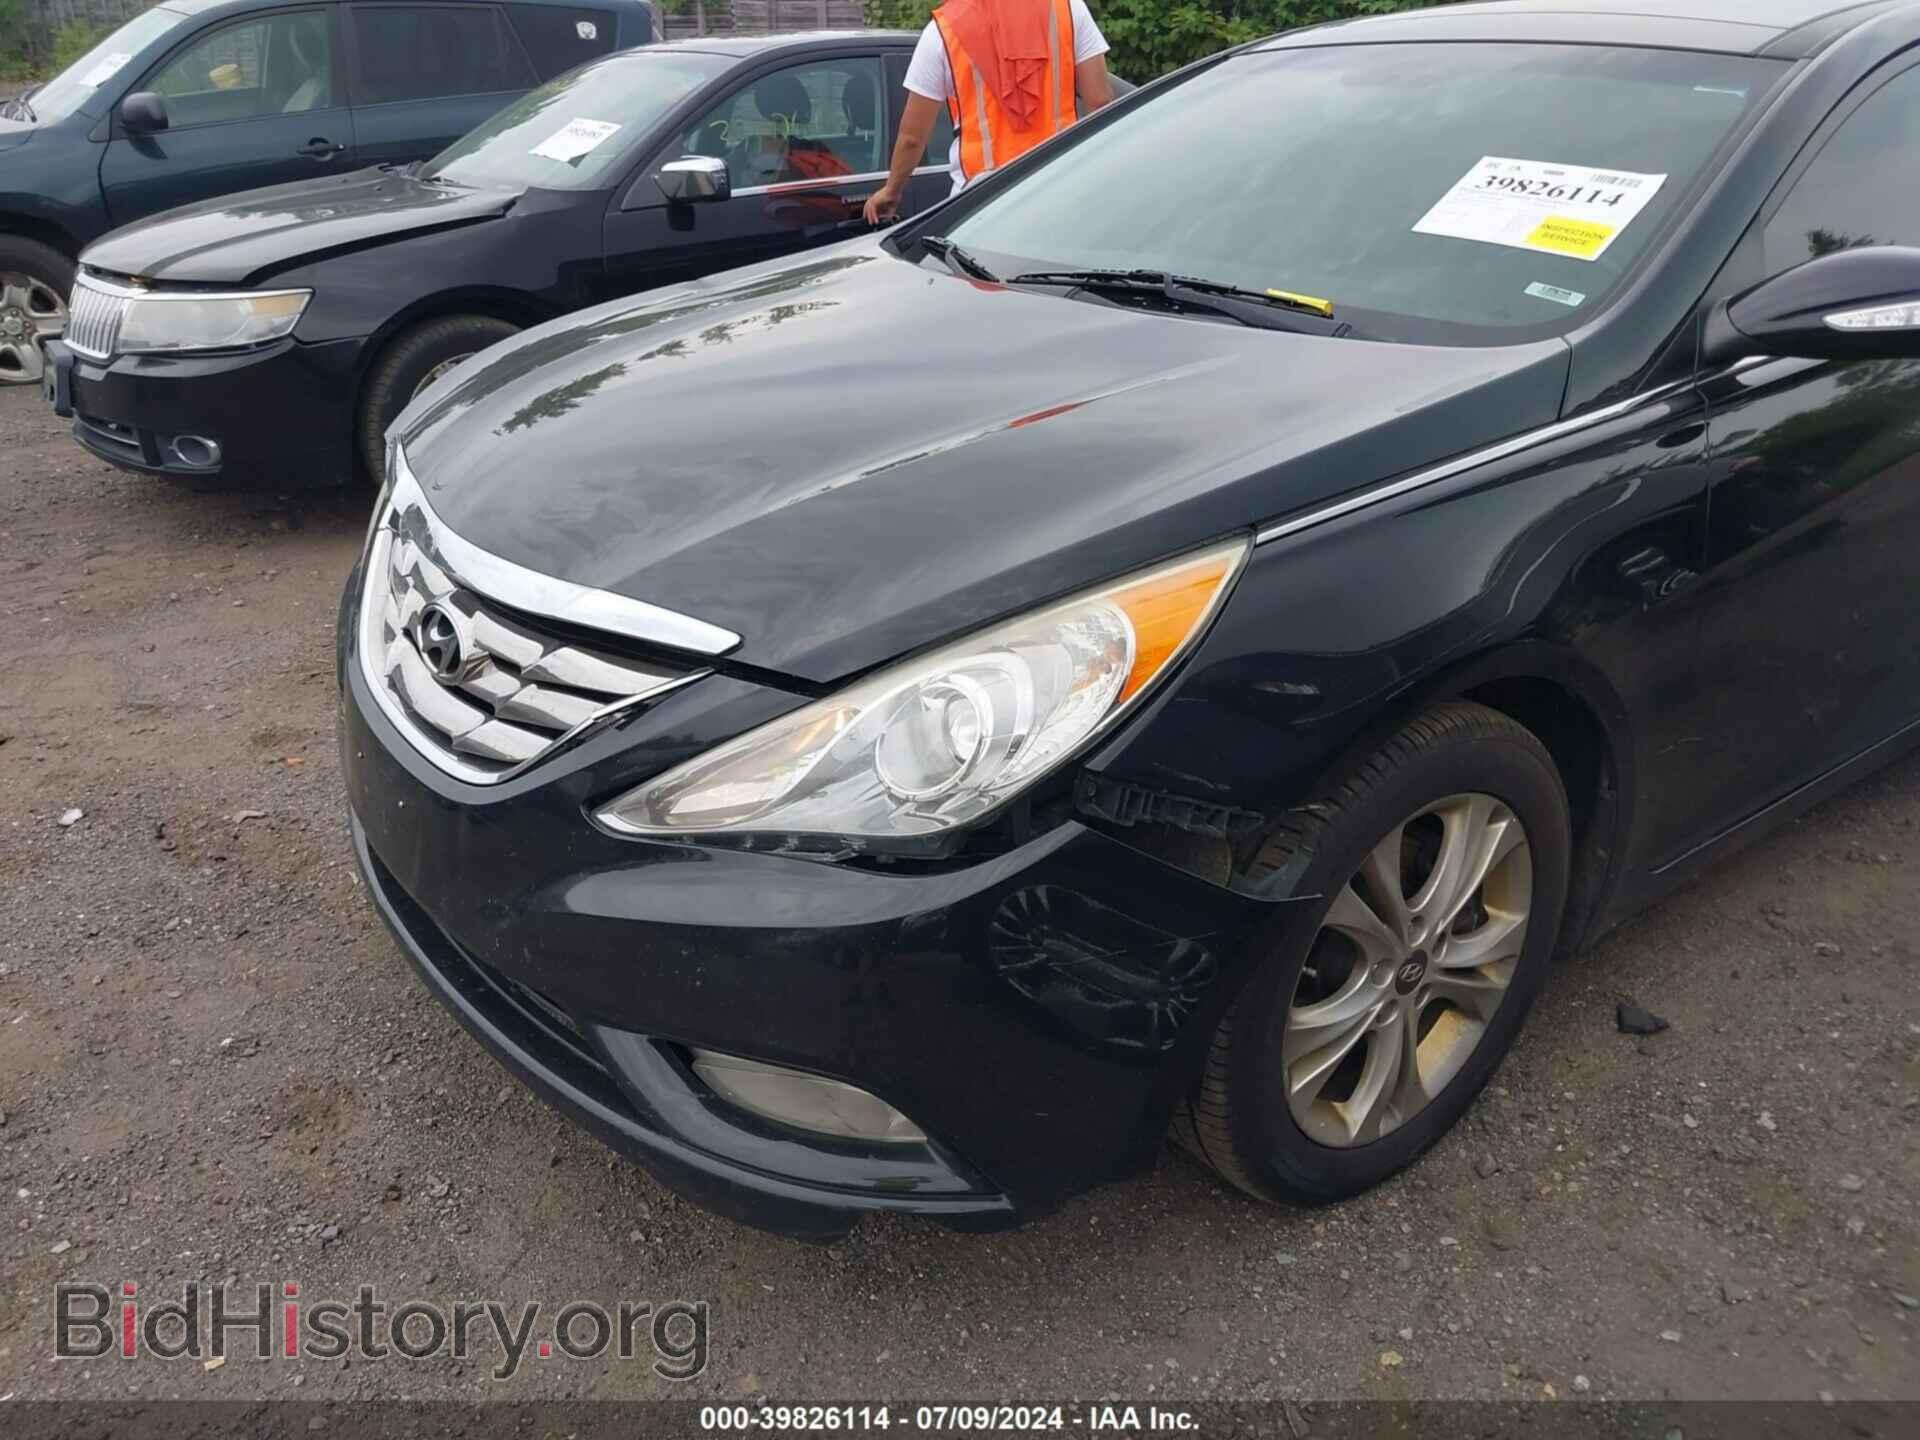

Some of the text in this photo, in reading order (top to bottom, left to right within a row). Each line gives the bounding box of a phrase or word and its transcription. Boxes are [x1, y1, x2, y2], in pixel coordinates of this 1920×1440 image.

[1474, 175, 1625, 207] 39826114
[1540, 223, 1607, 241] INSPECTION
[1541, 232, 1593, 247] SERVICE
